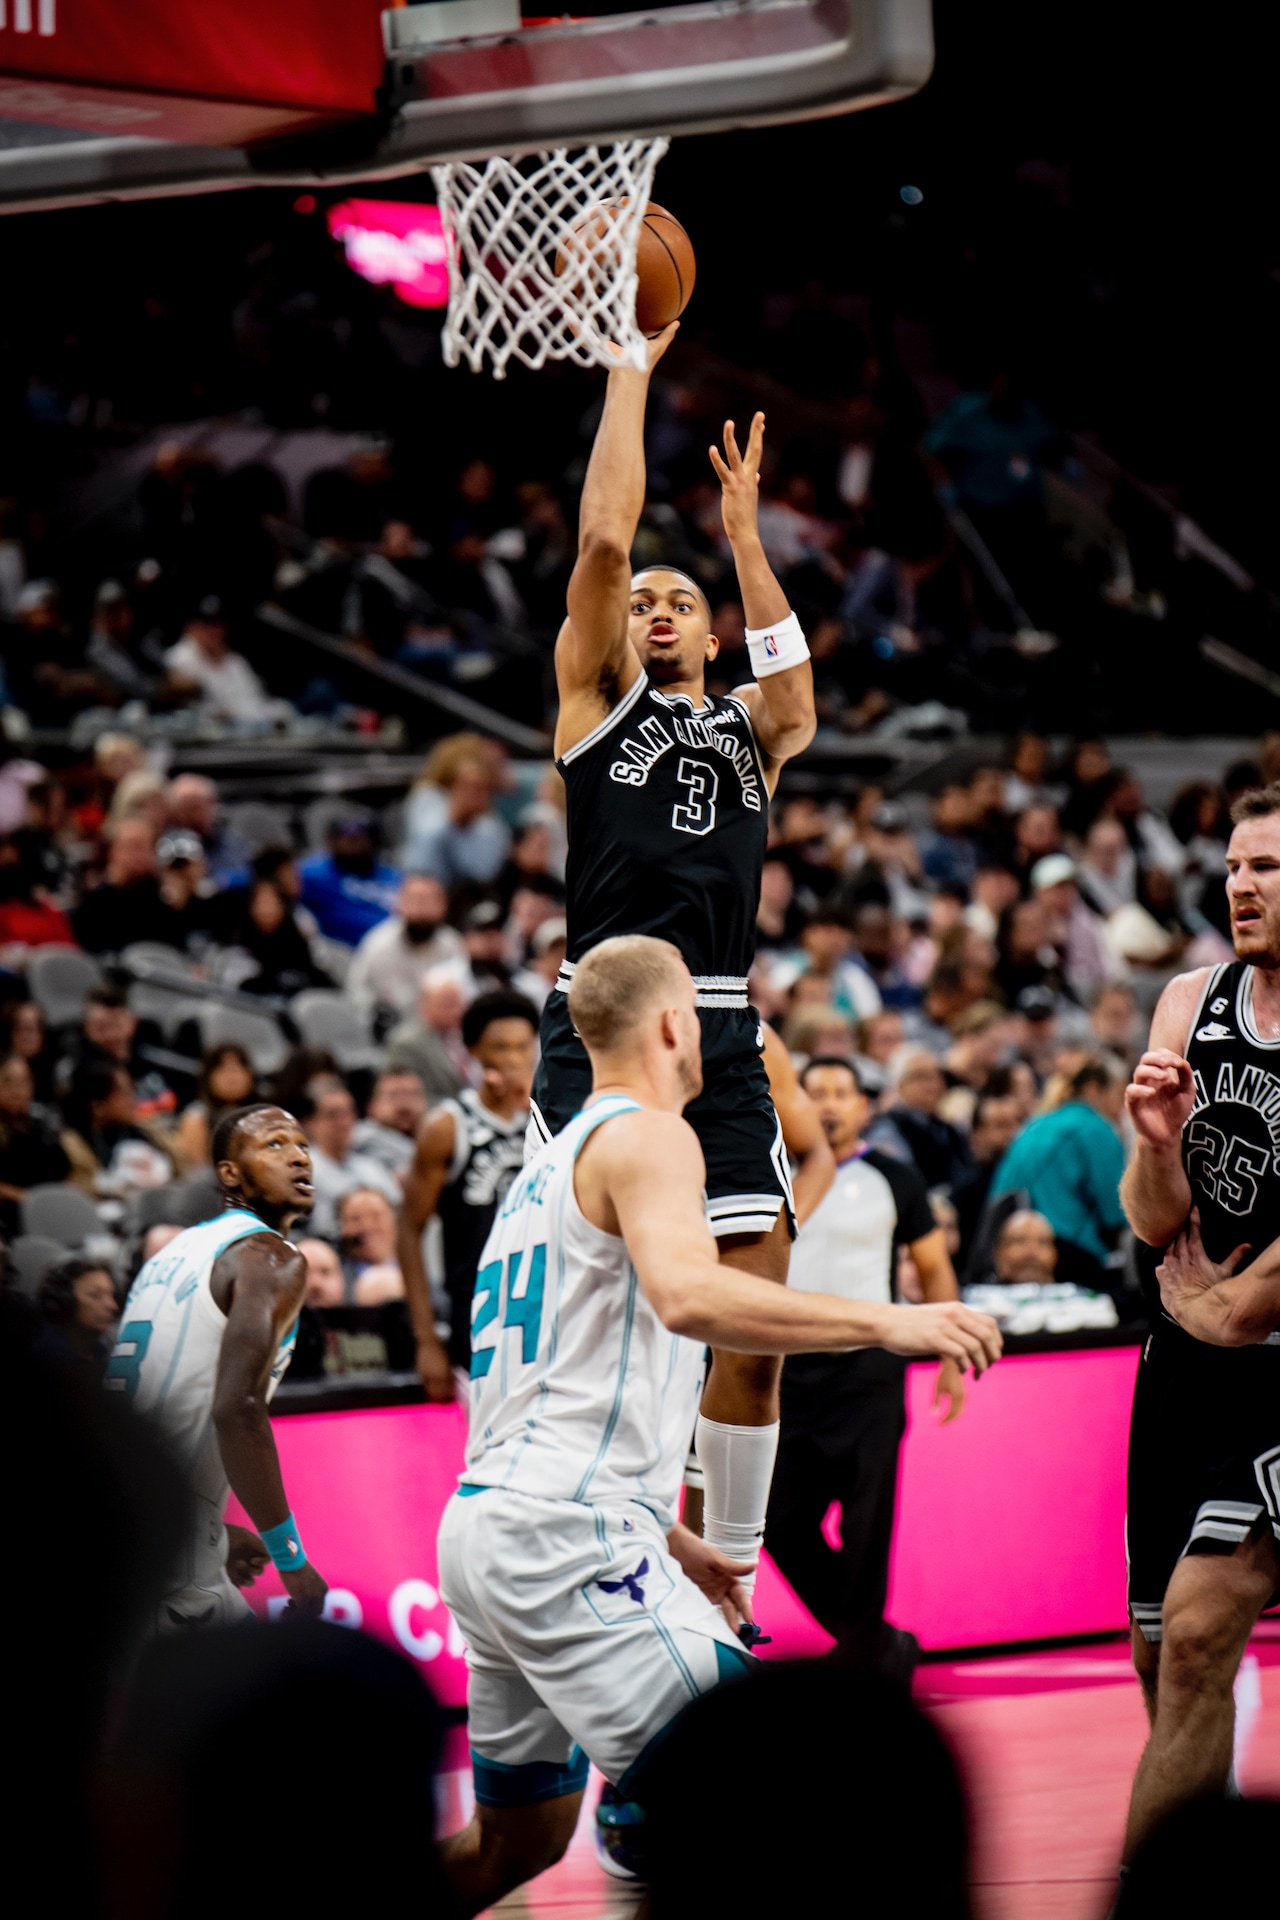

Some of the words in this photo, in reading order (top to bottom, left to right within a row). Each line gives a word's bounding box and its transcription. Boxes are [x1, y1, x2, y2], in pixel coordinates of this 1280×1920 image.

[609, 715, 675, 788] SAN
[671, 756, 719, 837] 3
[1209, 996, 1230, 1016] 6
[1187, 1120, 1271, 1217] 25
[469, 1243, 548, 1382] 24
